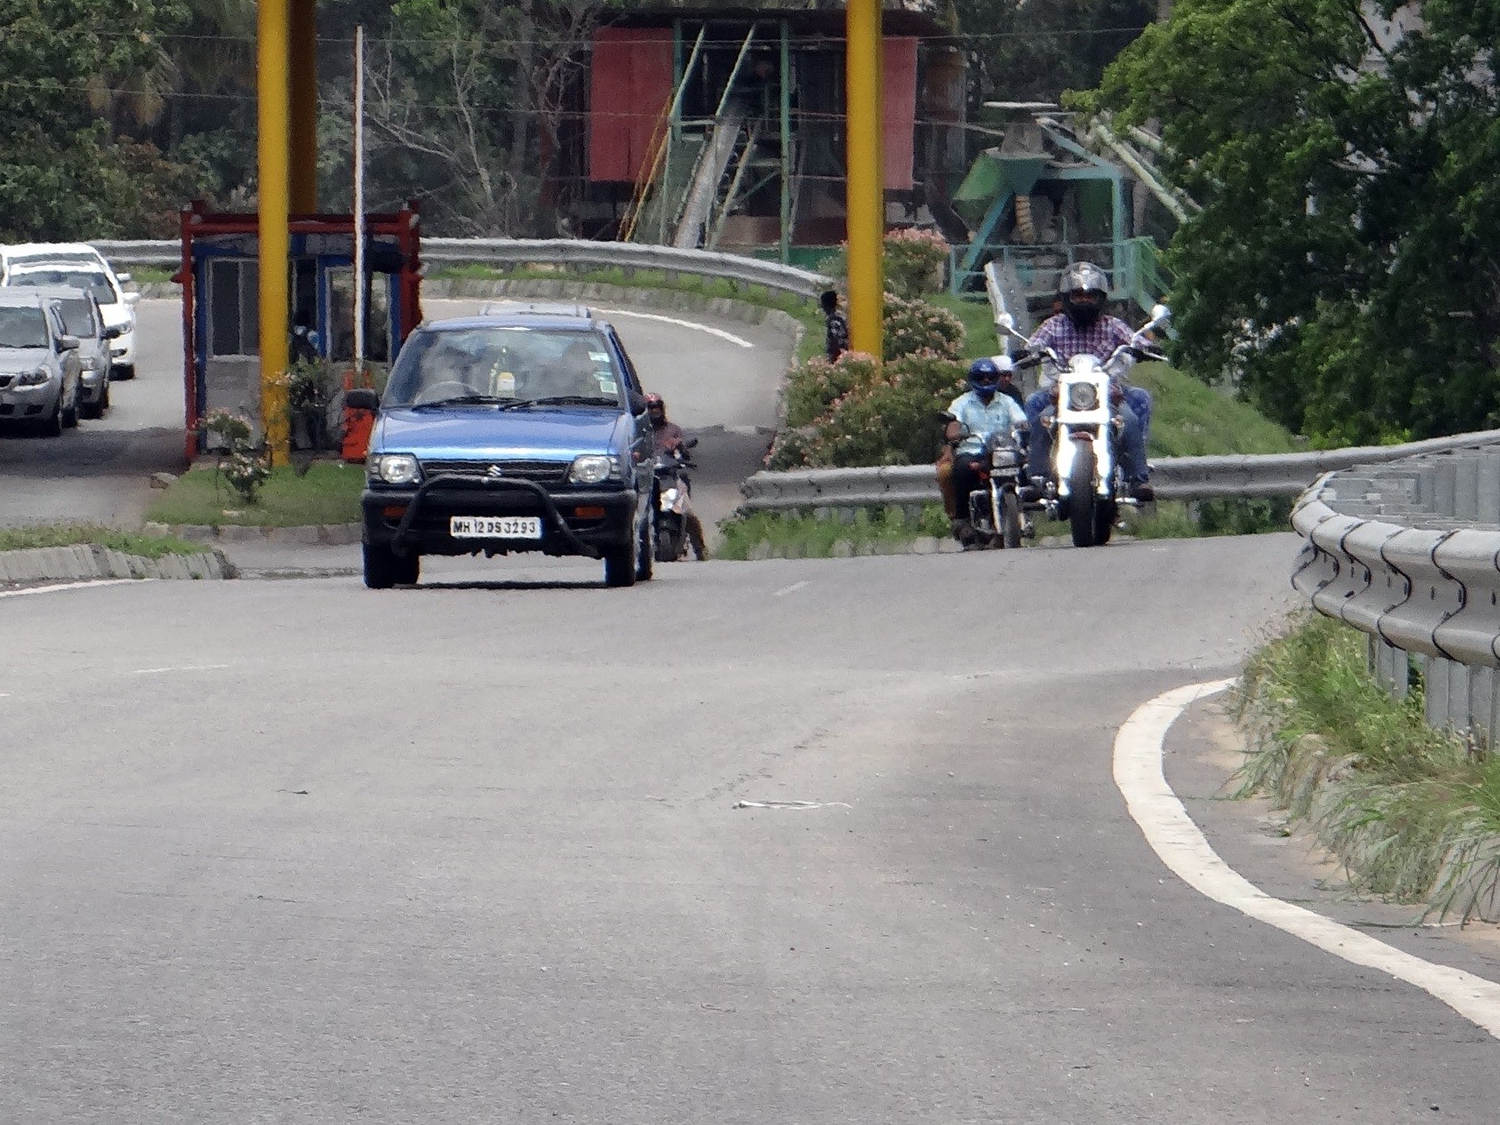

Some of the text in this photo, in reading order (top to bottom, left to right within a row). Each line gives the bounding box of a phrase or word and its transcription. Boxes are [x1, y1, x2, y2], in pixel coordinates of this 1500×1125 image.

[453, 521, 470, 533] MH
[474, 521, 485, 533] 12
[504, 521, 536, 533] 3293
